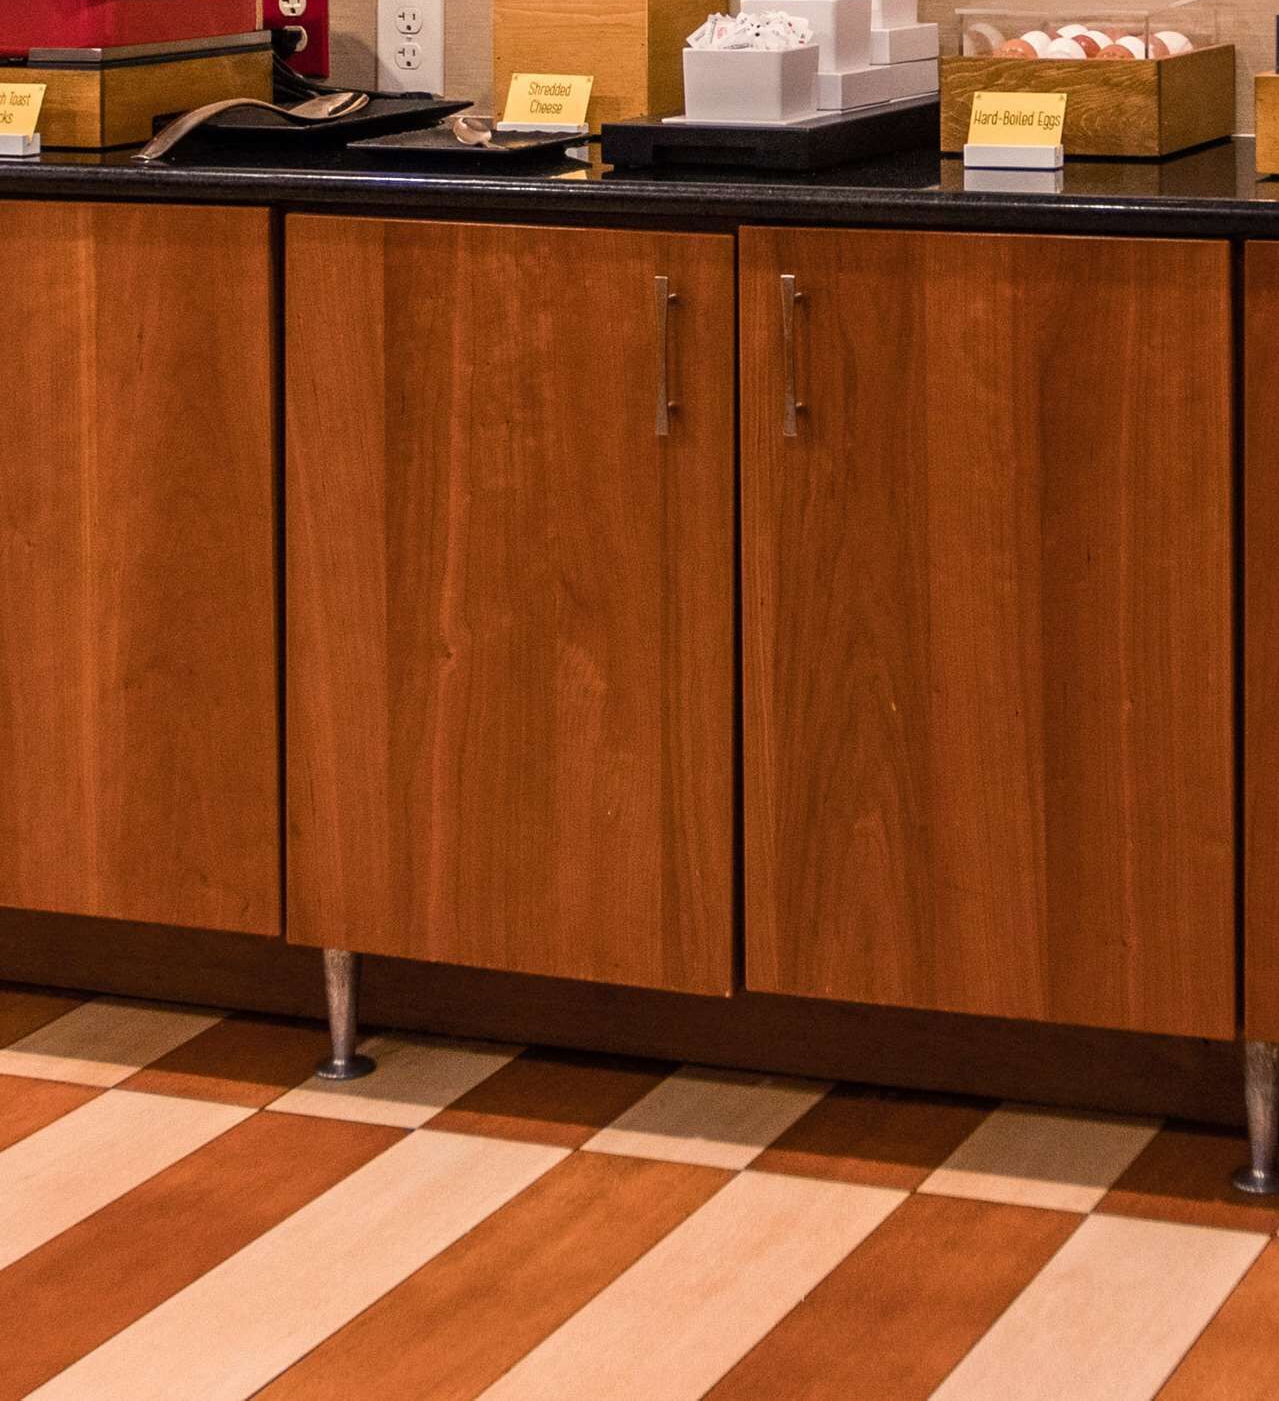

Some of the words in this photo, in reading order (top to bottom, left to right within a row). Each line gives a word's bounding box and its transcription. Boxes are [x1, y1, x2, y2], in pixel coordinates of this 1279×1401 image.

[528, 81, 571, 97] Shredded
[9, 91, 31, 106] Toast
[530, 99, 563, 115] Cheese
[974, 110, 1035, 126] Hard-Boiled
[1037, 110, 1061, 130] Eggs
